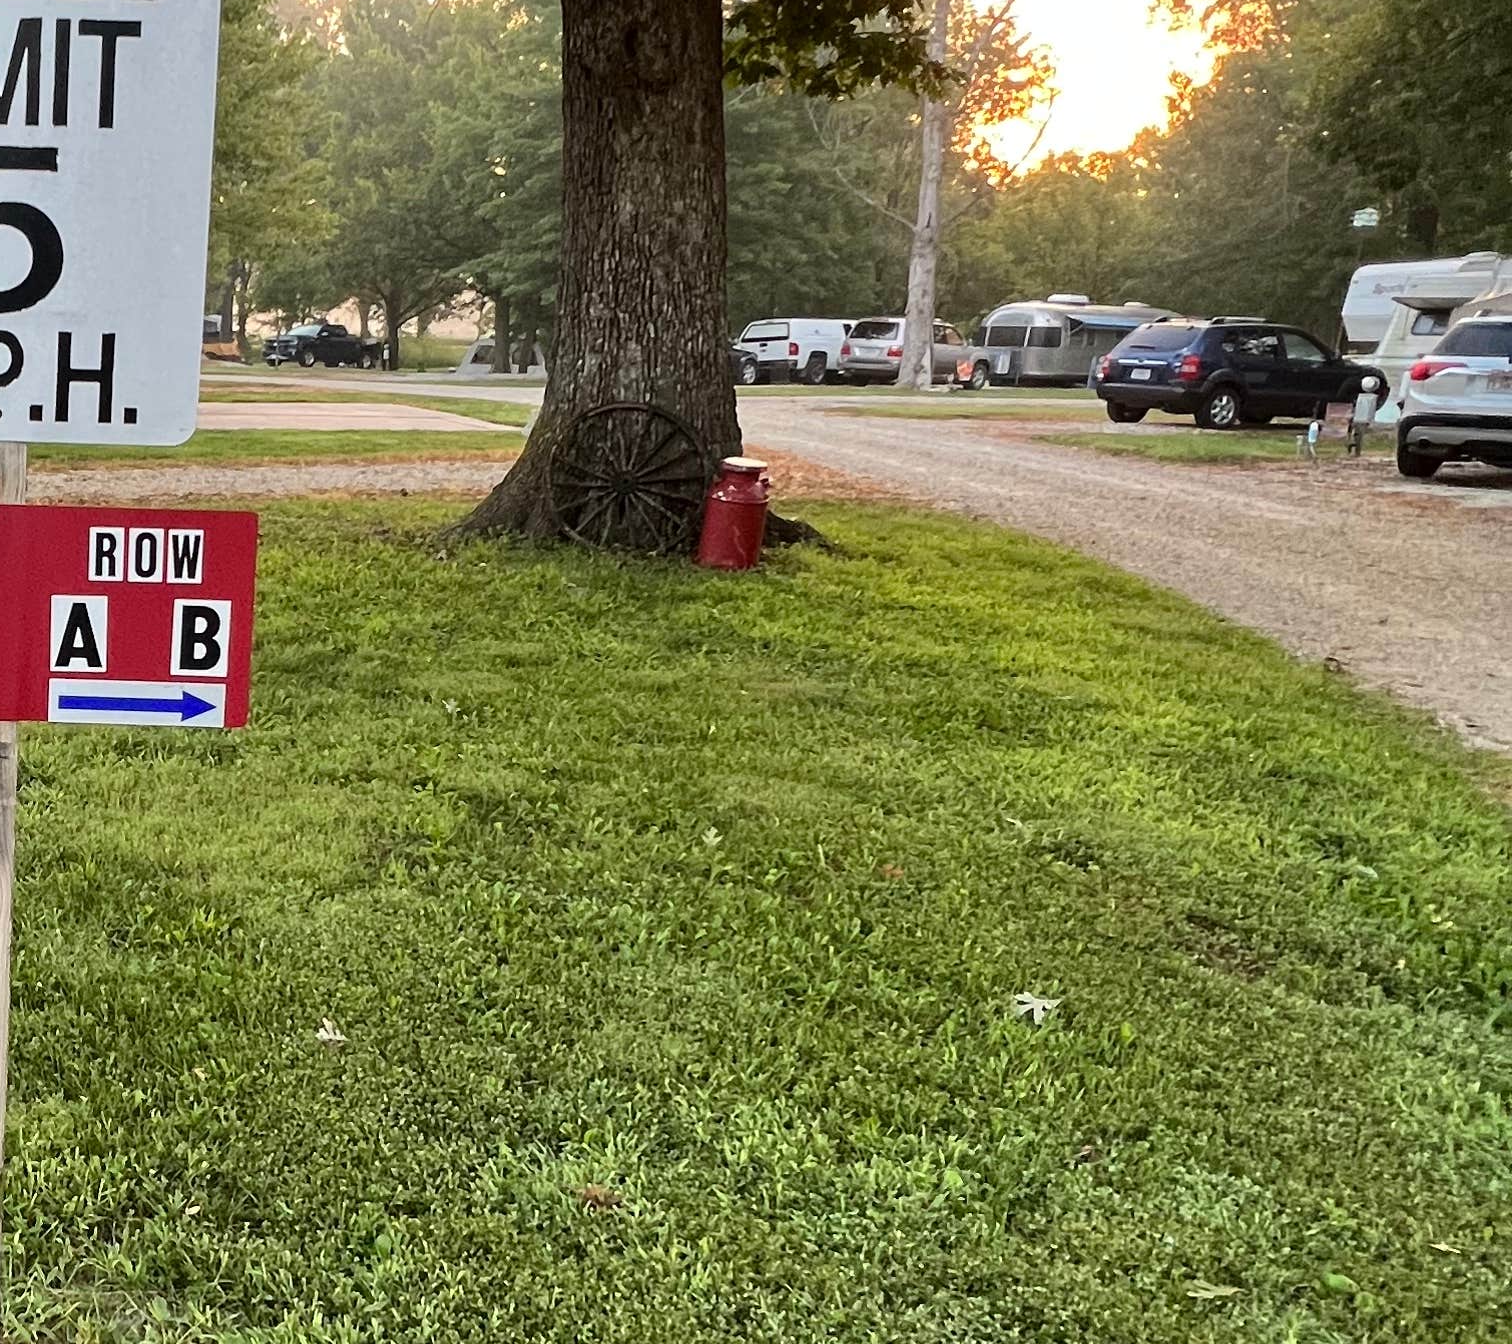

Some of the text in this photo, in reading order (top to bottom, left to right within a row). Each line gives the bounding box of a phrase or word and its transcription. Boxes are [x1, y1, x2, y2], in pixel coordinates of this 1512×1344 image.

[94, 531, 202, 580] ROW
[54, 601, 222, 672] A B
